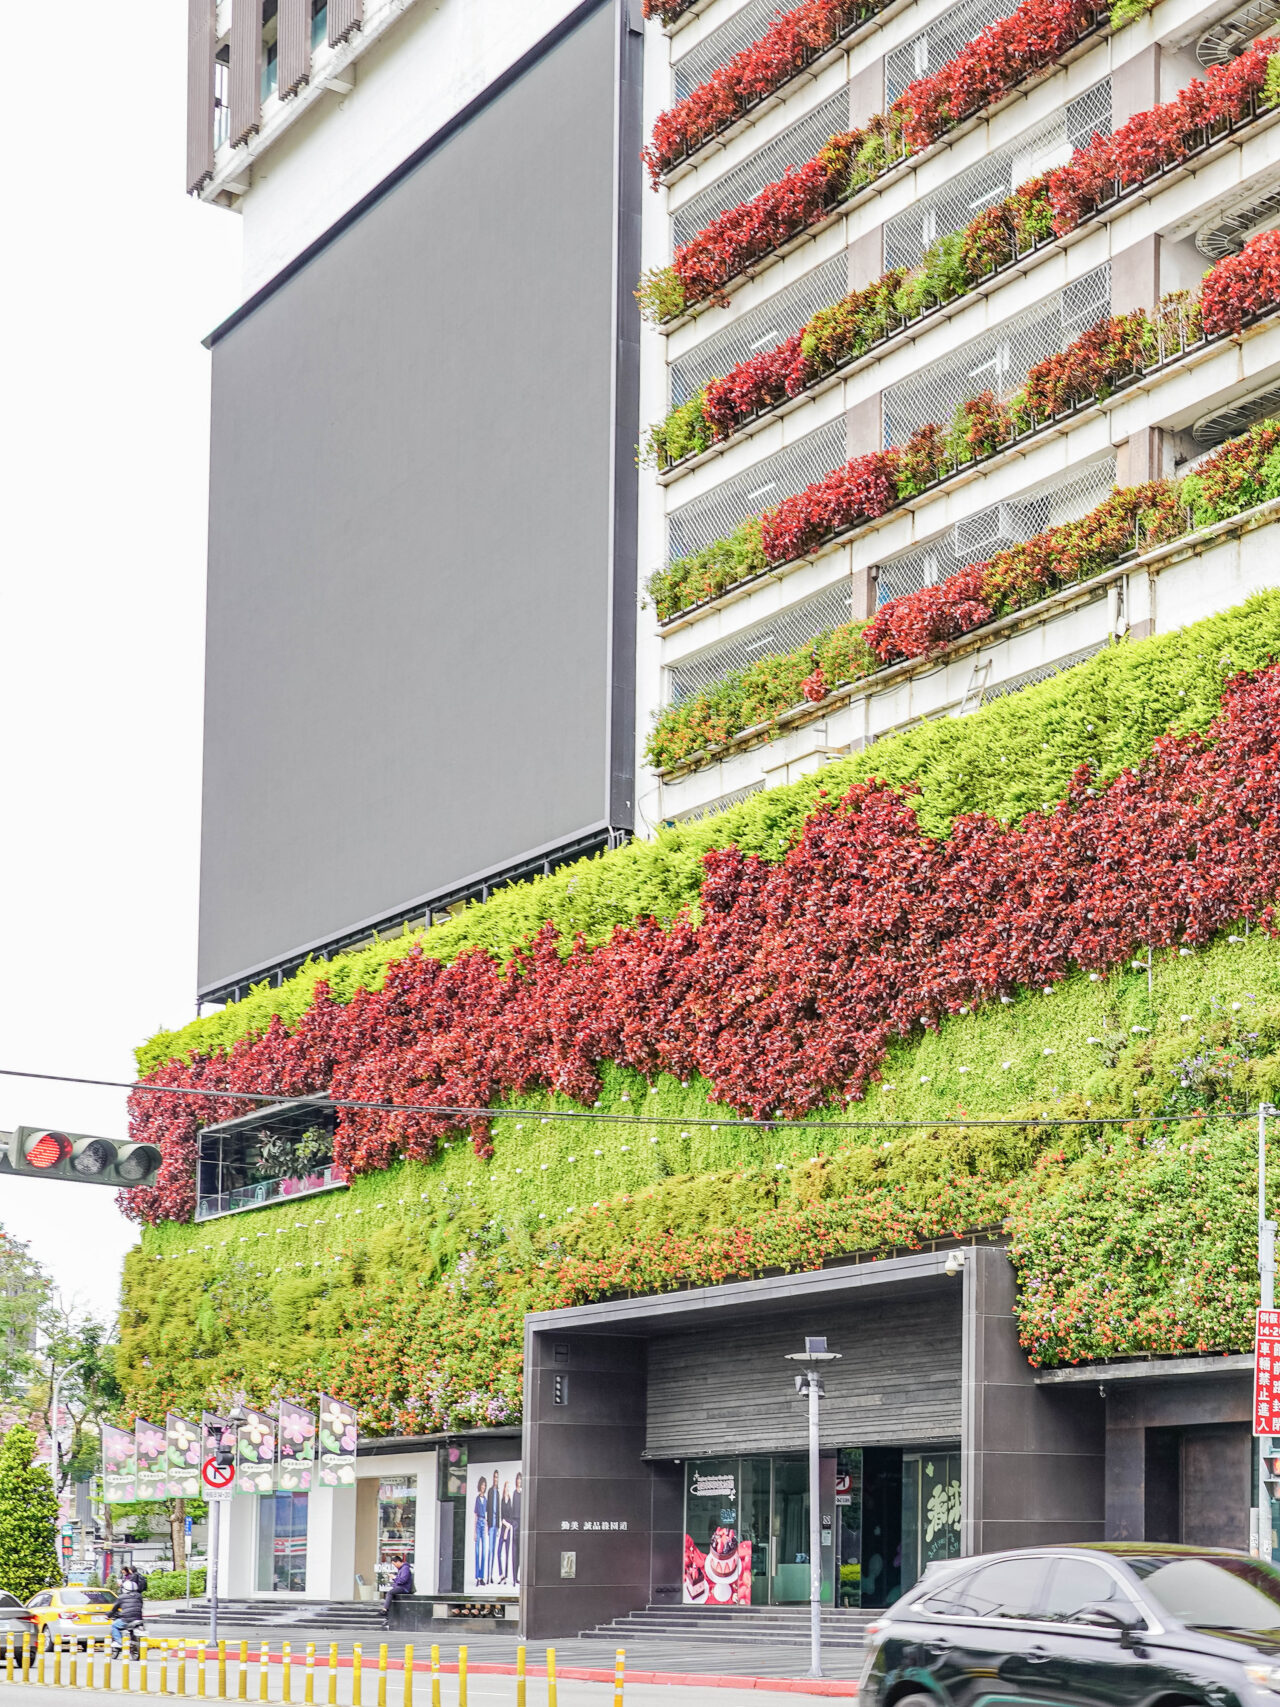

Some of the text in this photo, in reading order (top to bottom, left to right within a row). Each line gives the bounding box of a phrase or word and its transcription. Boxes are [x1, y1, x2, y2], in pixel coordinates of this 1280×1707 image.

[1258, 1342, 1271, 1431] 車輛禁止進入
